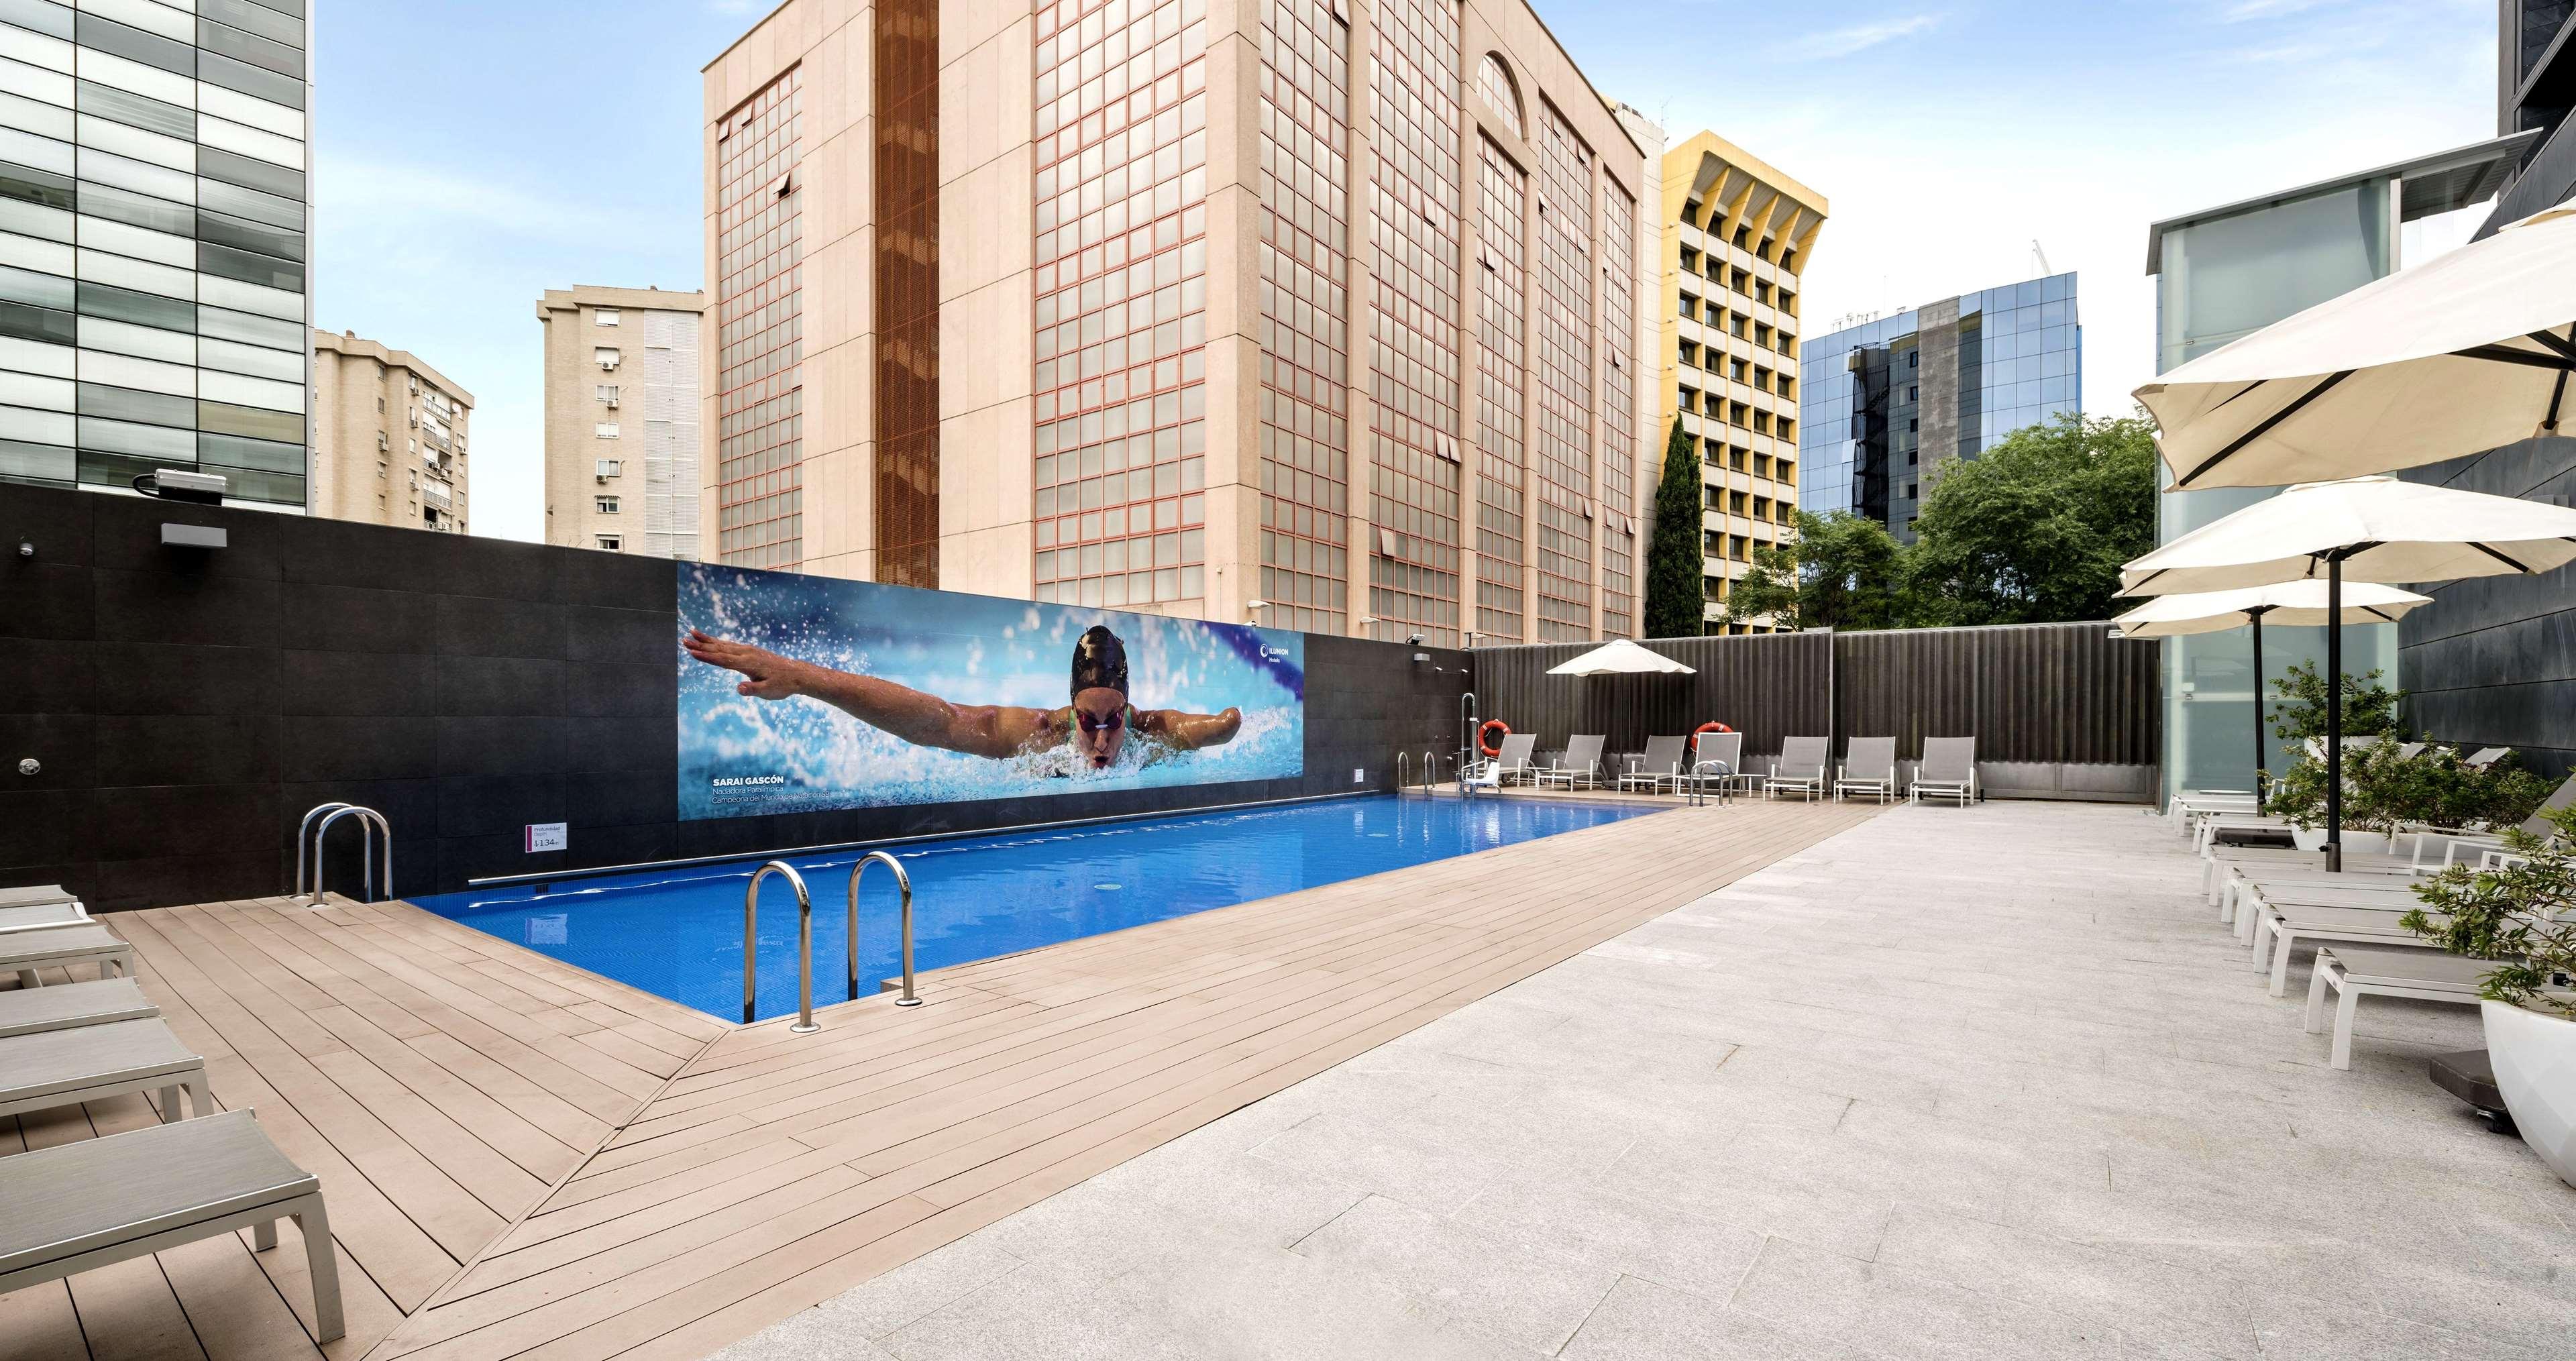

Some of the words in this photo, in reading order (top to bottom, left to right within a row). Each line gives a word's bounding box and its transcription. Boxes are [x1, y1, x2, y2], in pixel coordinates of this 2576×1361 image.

[712, 777, 743, 786] SARAI
[745, 775, 784, 785] GASCÓN
[712, 787, 746, 796] Nadadora
[747, 785, 784, 795] Paralímpica
[712, 796, 749, 805] Campeona
[761, 793, 784, 801] Mundo
